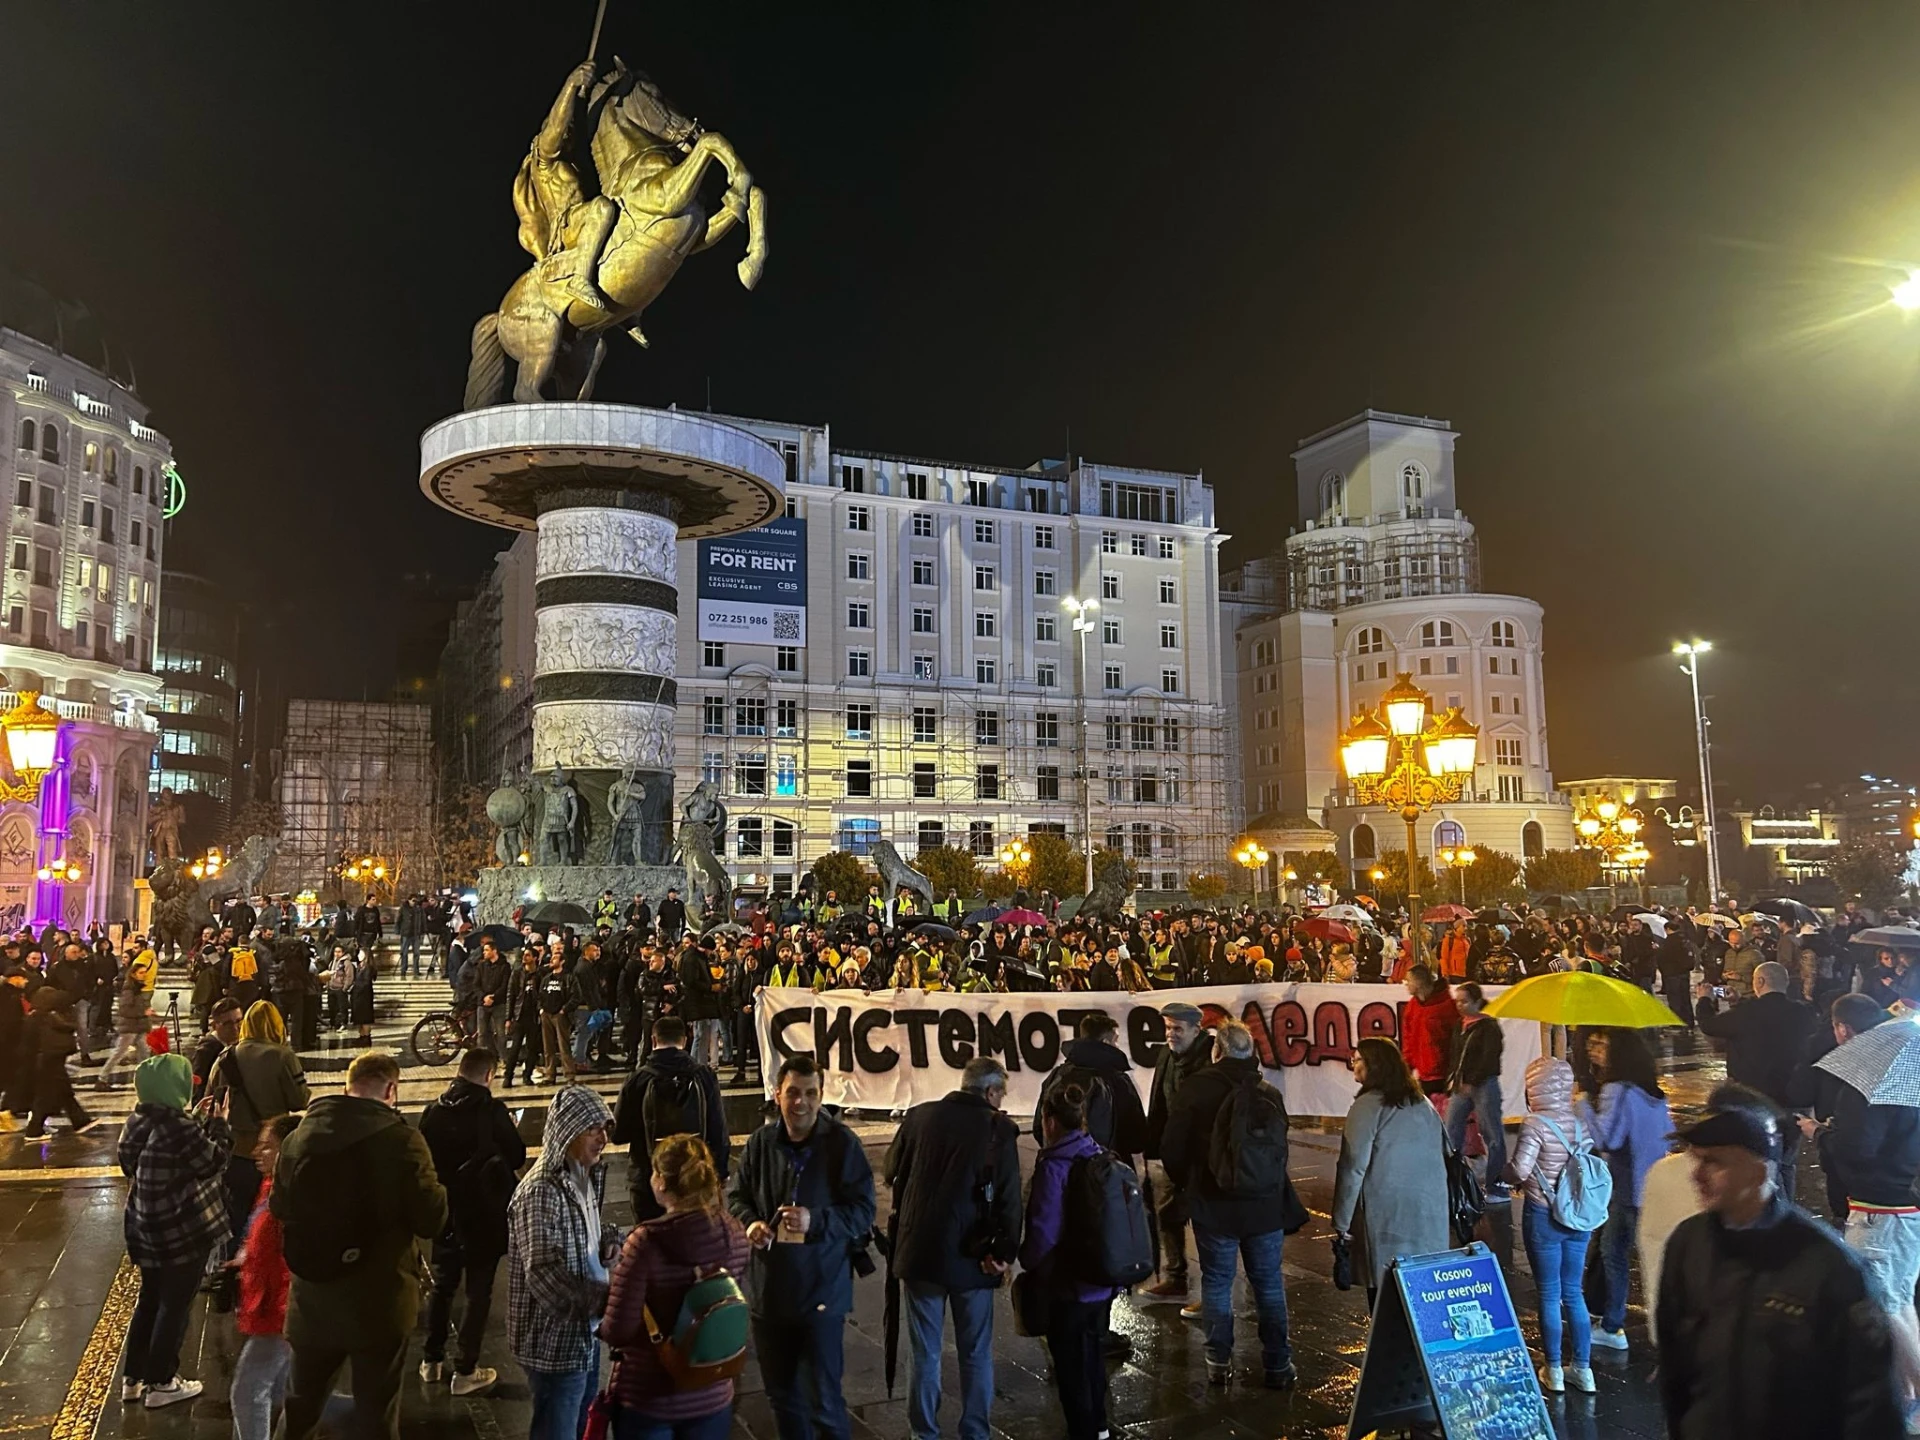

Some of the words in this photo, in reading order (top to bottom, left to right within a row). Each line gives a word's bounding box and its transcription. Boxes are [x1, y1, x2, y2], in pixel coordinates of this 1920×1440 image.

[770, 528, 797, 536] SQUARE
[710, 552, 746, 568] FOR
[751, 555, 797, 572] RENT
[708, 576, 745, 584] EXCLUSIVE
[777, 581, 798, 590] CBS
[708, 613, 728, 622] 072
[730, 615, 747, 624] 251
[749, 616, 768, 625] 986
[1433, 1267, 1473, 1283] Kosovo
[1421, 1290, 1445, 1303] tour
[1447, 1280, 1493, 1299] everyday
[1451, 1304, 1478, 1315] 8:00am
